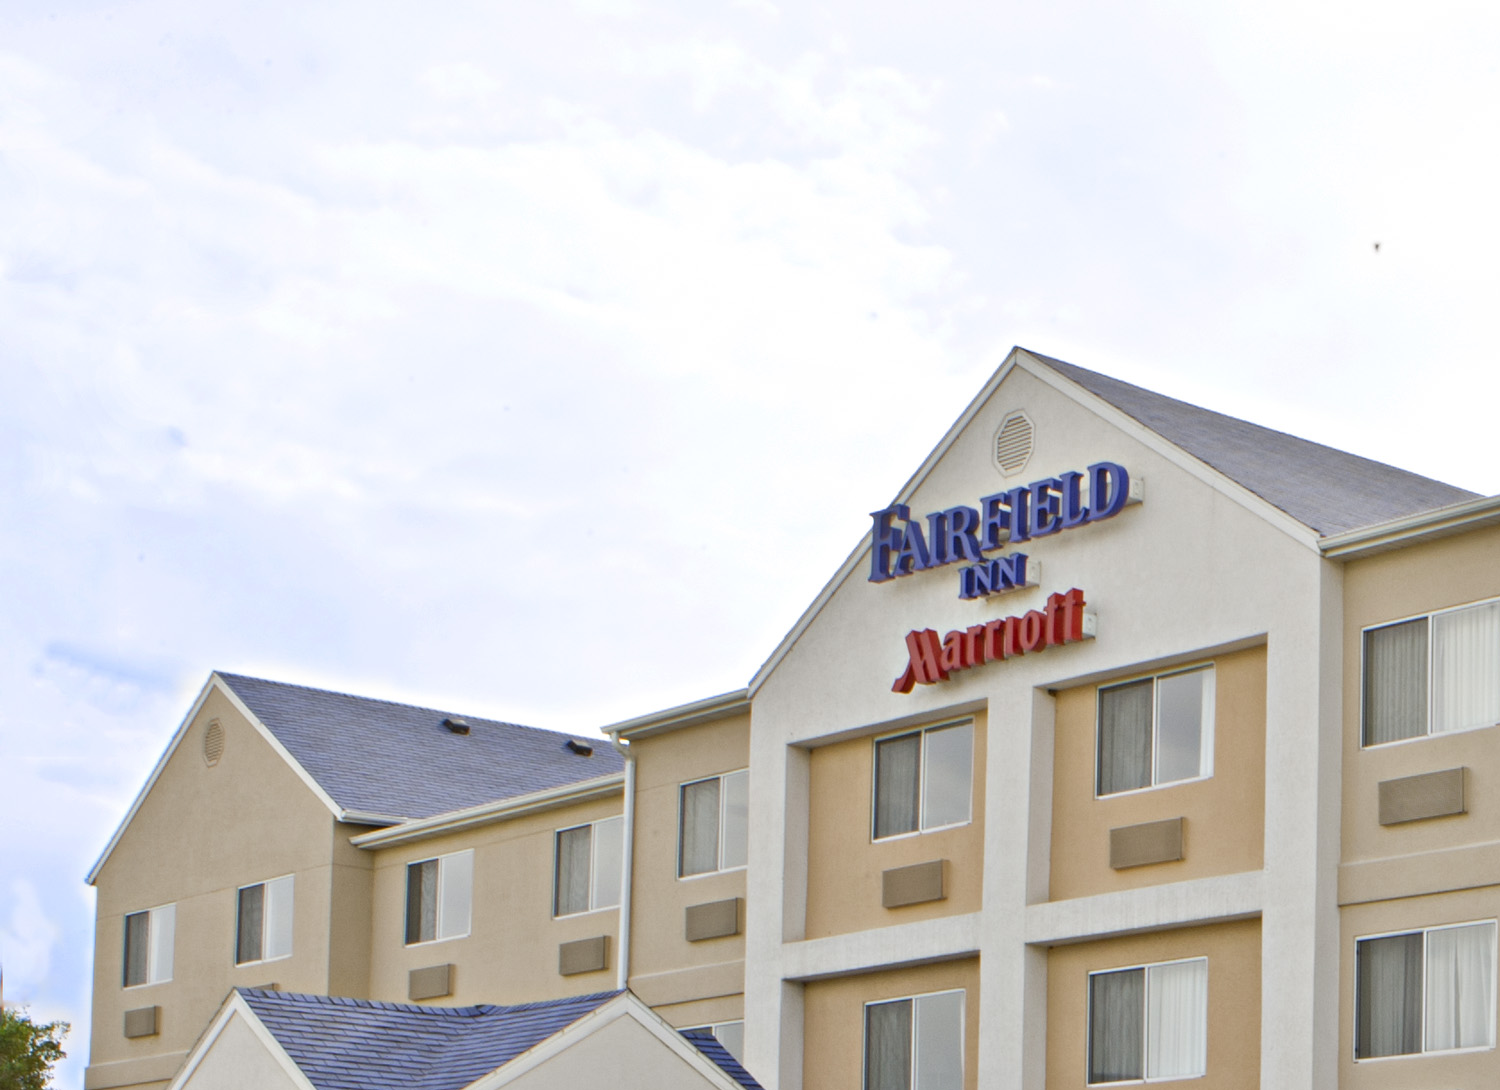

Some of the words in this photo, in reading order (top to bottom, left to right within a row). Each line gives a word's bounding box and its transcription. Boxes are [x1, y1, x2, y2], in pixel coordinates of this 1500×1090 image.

[868, 461, 1130, 582] FAIRFIELD
[958, 552, 1029, 600] INN
[891, 587, 1087, 694] Marriott
